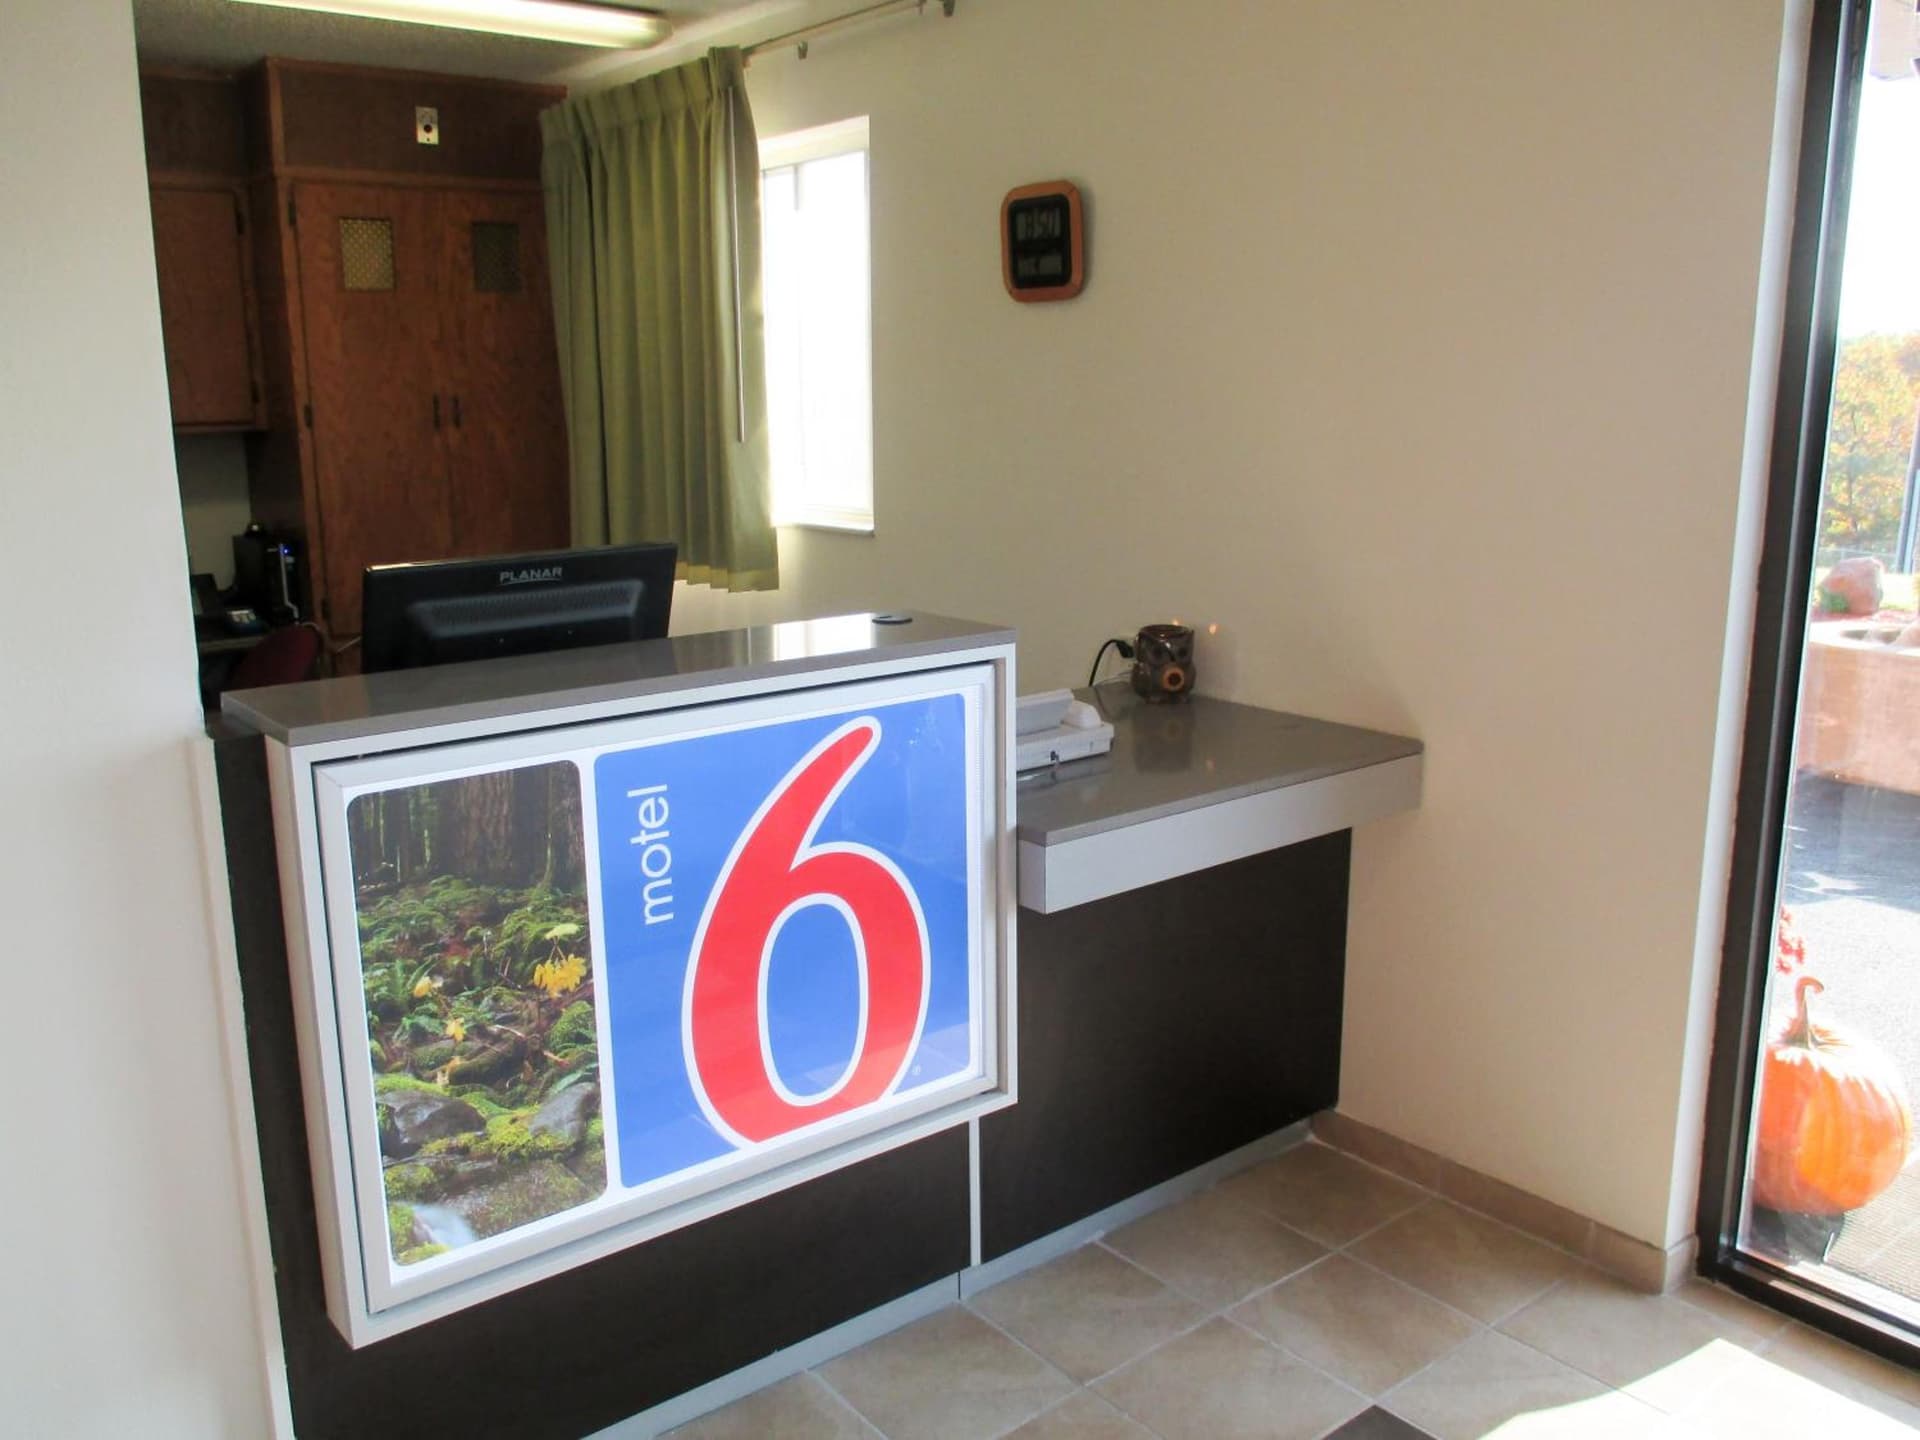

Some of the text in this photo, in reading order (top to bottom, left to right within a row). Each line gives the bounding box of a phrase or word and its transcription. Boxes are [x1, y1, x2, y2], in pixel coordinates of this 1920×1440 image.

[500, 567, 563, 583] PLANAR
[627, 715, 931, 1149] motel 6
